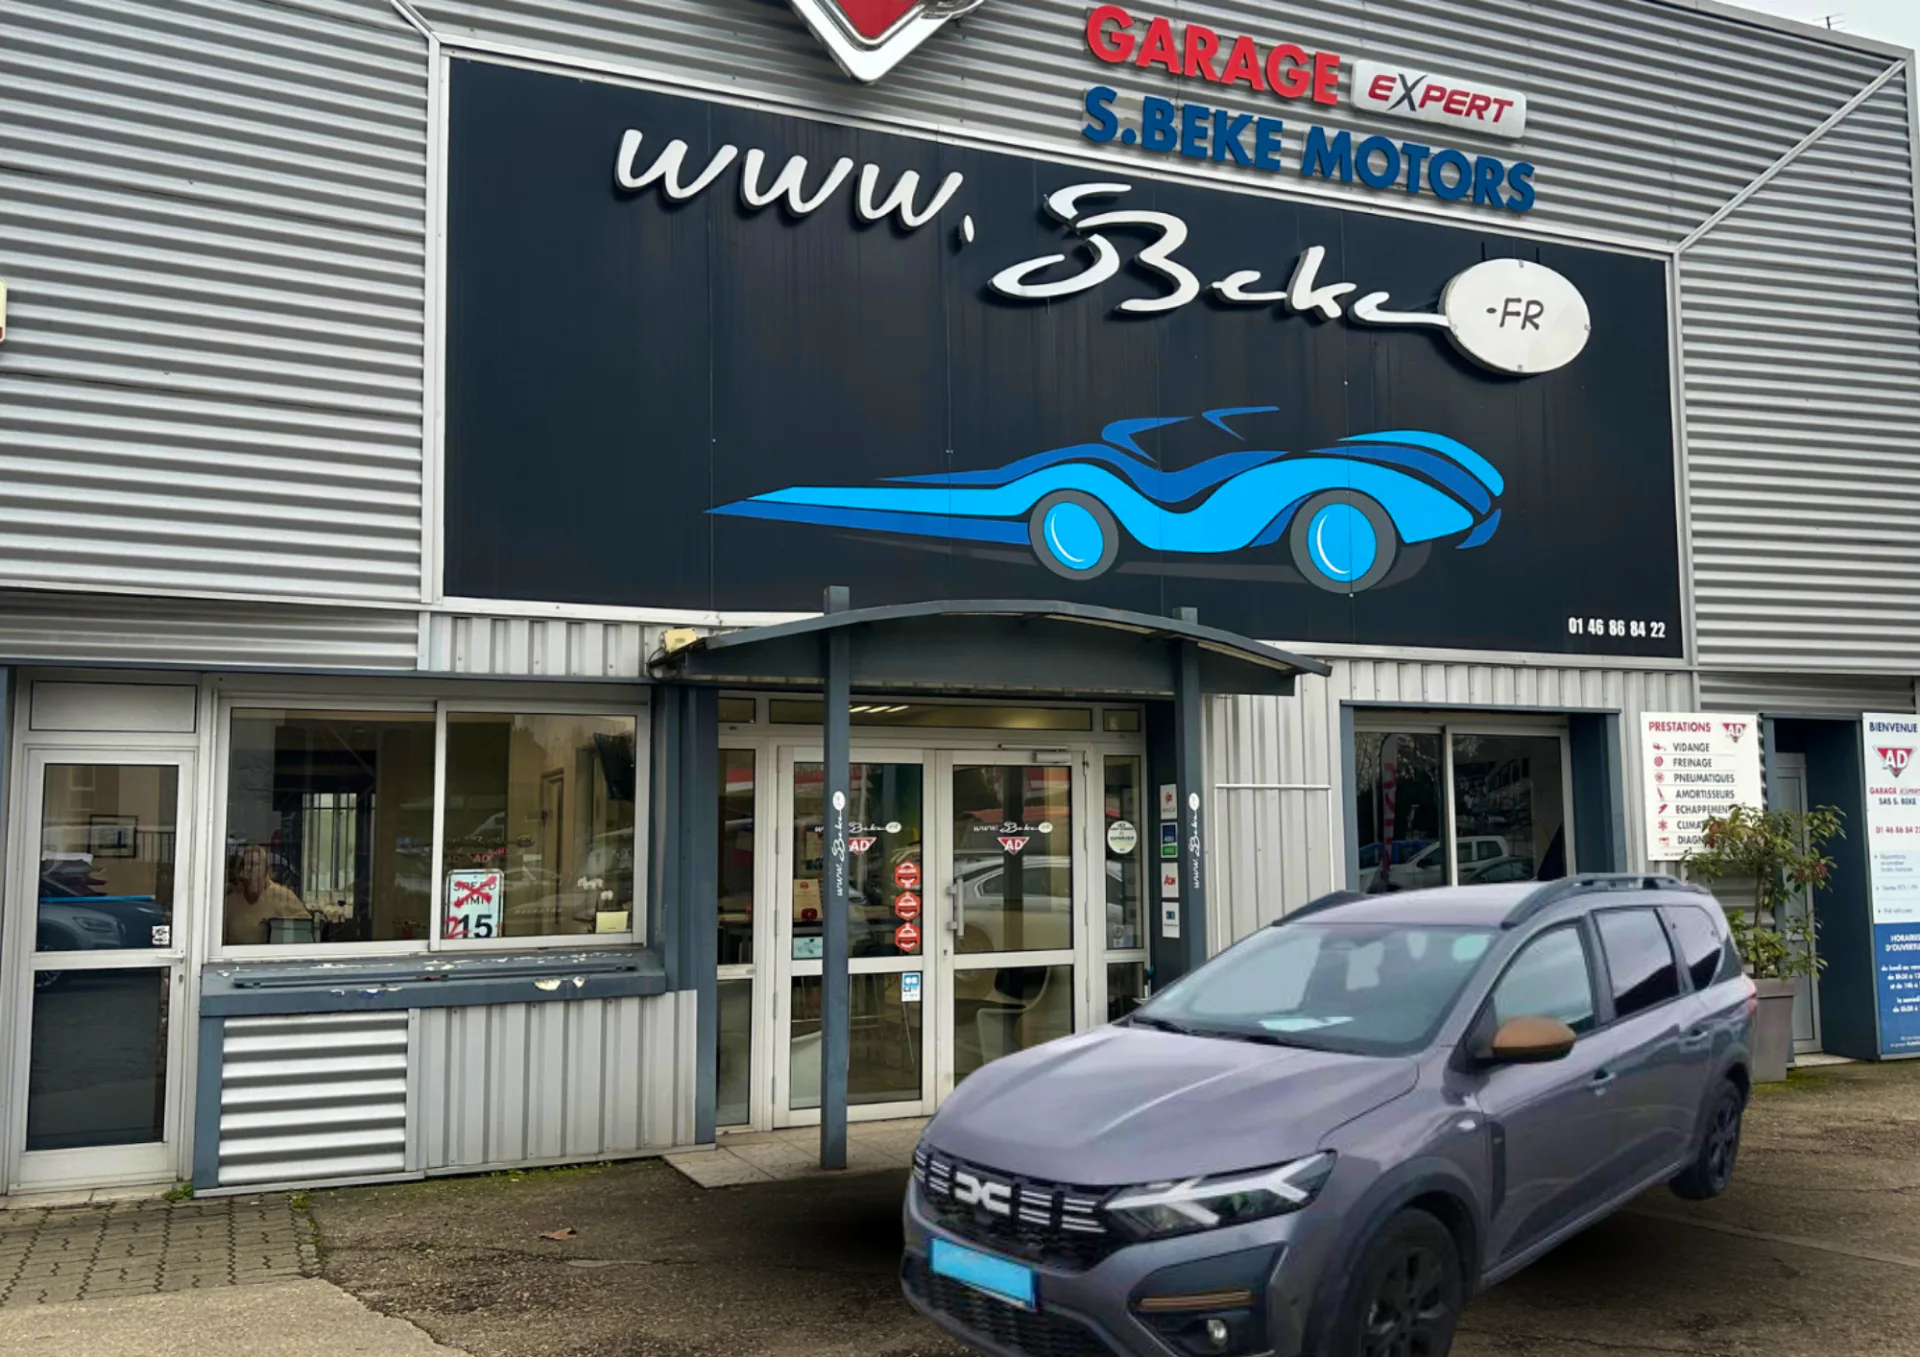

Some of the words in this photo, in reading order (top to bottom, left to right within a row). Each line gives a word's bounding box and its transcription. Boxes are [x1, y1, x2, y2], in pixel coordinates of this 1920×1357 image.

[1085, 5, 1341, 106] GARAGE
[1367, 72, 1514, 123] EXPERT
[1081, 85, 1284, 172] S.BEKE
[1300, 125, 1537, 213] MOTORS
[1568, 617, 1583, 634] 01
[1588, 618, 1604, 635] 46
[1609, 619, 1625, 636] 86
[1630, 620, 1646, 637] 84
[1650, 621, 1666, 638] 22
[1649, 721, 1711, 733] PRESTATIONS
[1727, 725, 1744, 737] AD
[1869, 722, 1918, 732] BIENVENUE
[1673, 742, 1710, 752] VIDANGE
[1673, 758, 1712, 768] FREINAGE
[1884, 749, 1908, 768] AD
[1674, 773, 1735, 783] PNEUMATIQUES
[1675, 789, 1735, 799] AMORTISSEURS
[1869, 787, 1897, 795] GARAGE
[1879, 798, 1891, 806] SAS
[1675, 804, 1730, 814] ECHAPPEMEN
[849, 839, 870, 852] AD
[1004, 839, 1023, 851] AD
[1885, 943, 1920, 952] D'OUVERTU
